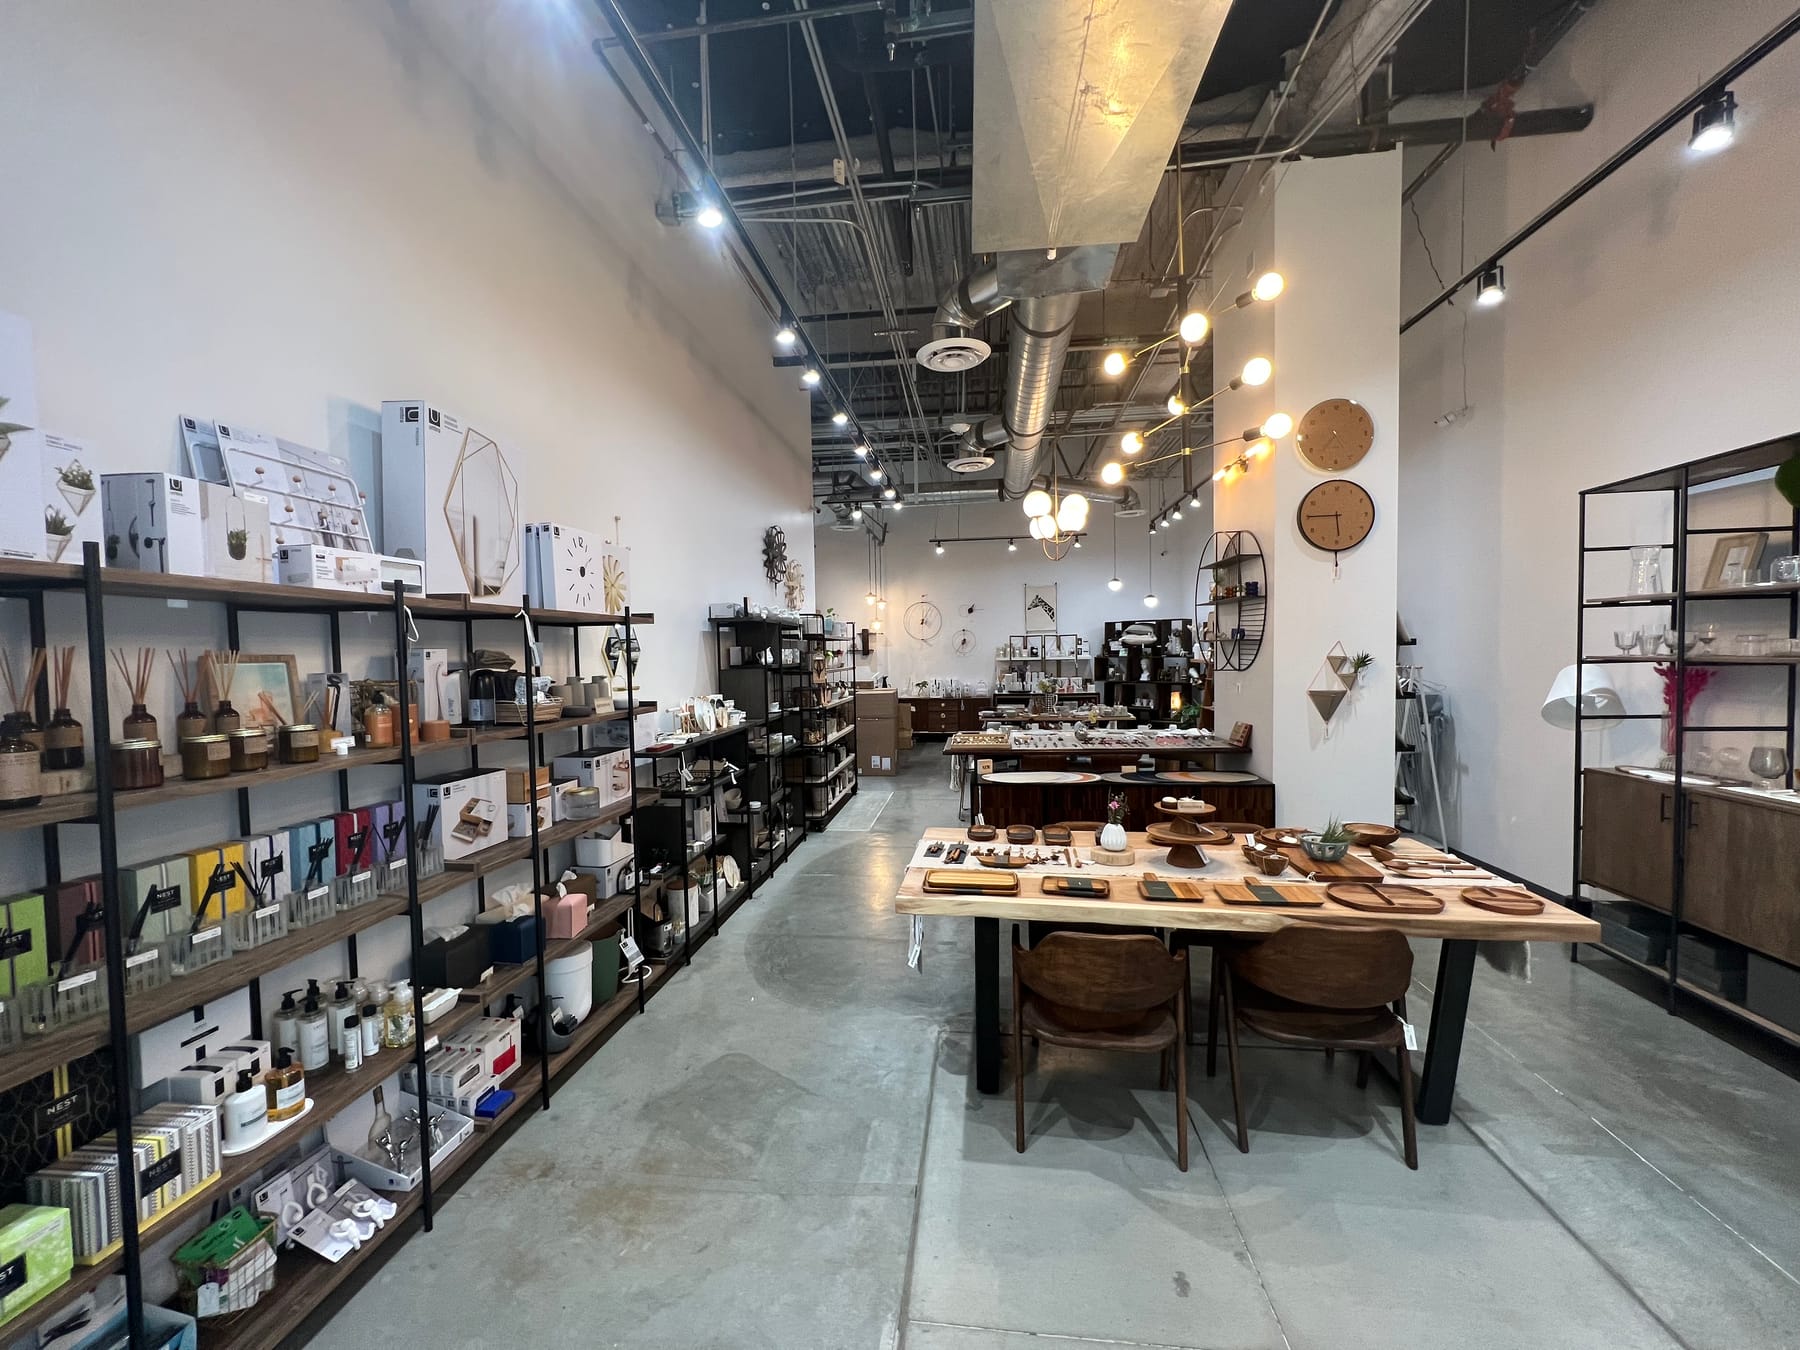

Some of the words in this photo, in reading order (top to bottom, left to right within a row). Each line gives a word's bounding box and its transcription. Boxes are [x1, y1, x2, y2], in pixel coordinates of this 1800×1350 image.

[156, 889, 175, 899] NEST
[47, 1094, 78, 1116] NEST
[149, 1158, 173, 1179] NEST
